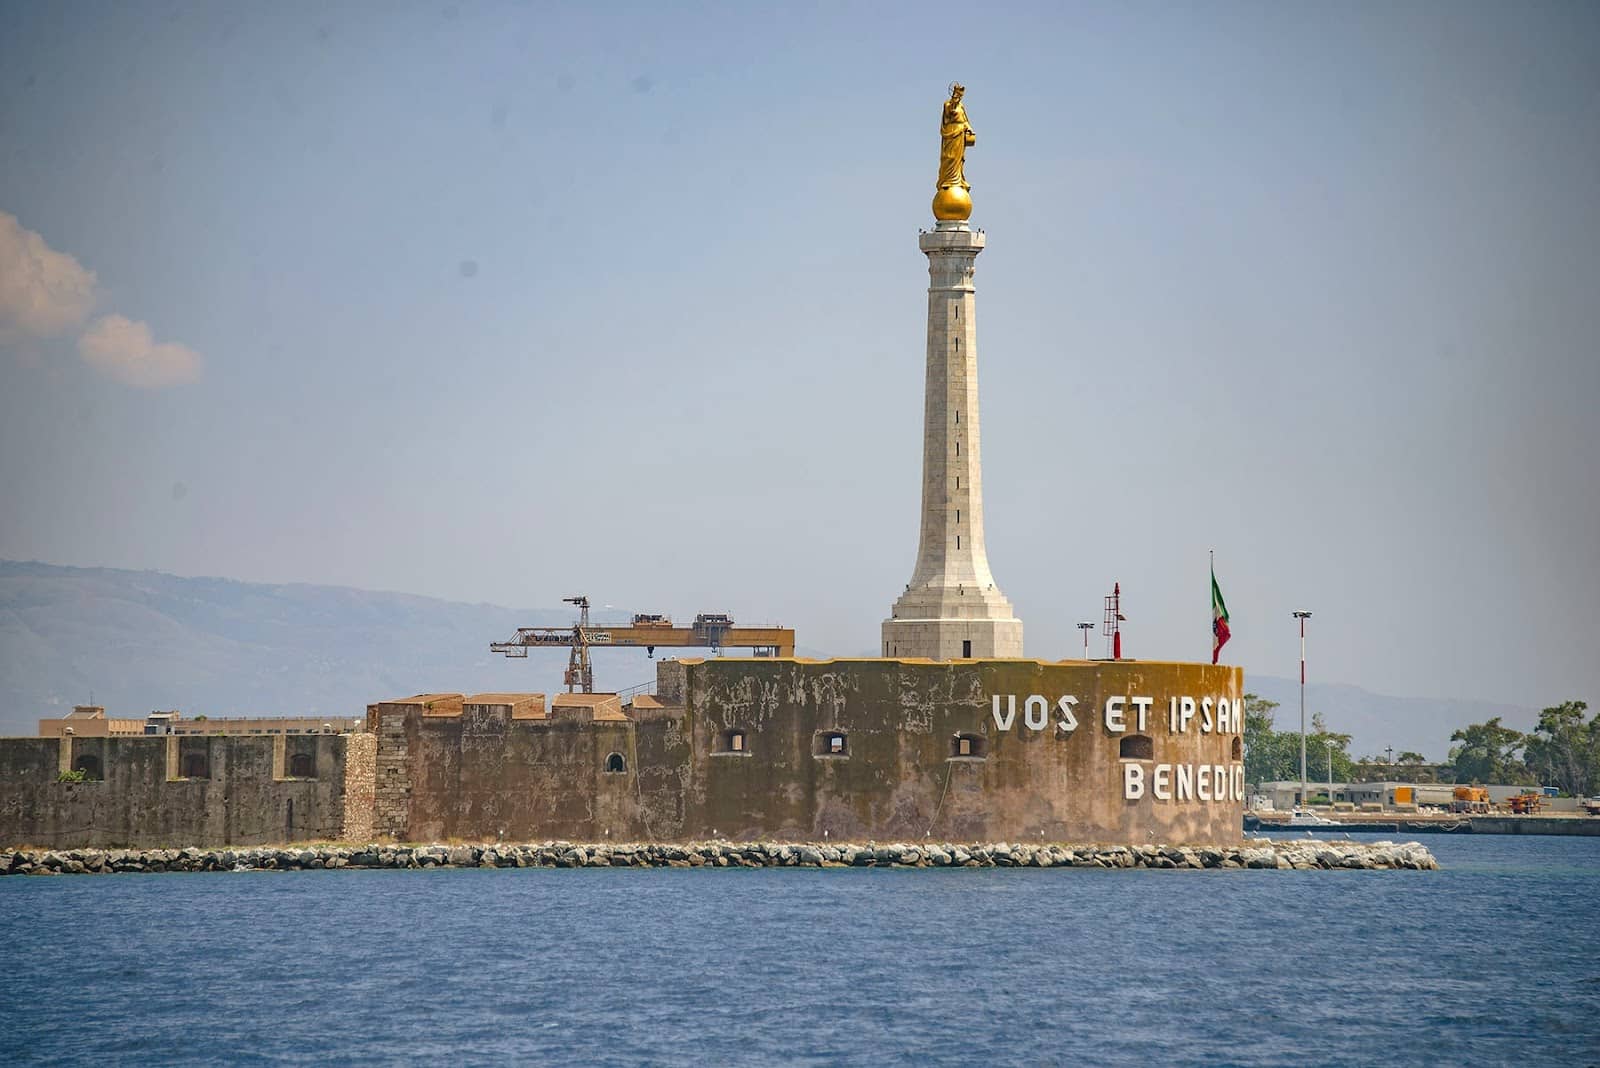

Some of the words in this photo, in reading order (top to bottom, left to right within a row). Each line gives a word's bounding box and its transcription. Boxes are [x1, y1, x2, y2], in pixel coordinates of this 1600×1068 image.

[992, 695, 1079, 731] VOS
[1105, 696, 1153, 732] ET
[1170, 697, 1241, 734] IPSAM
